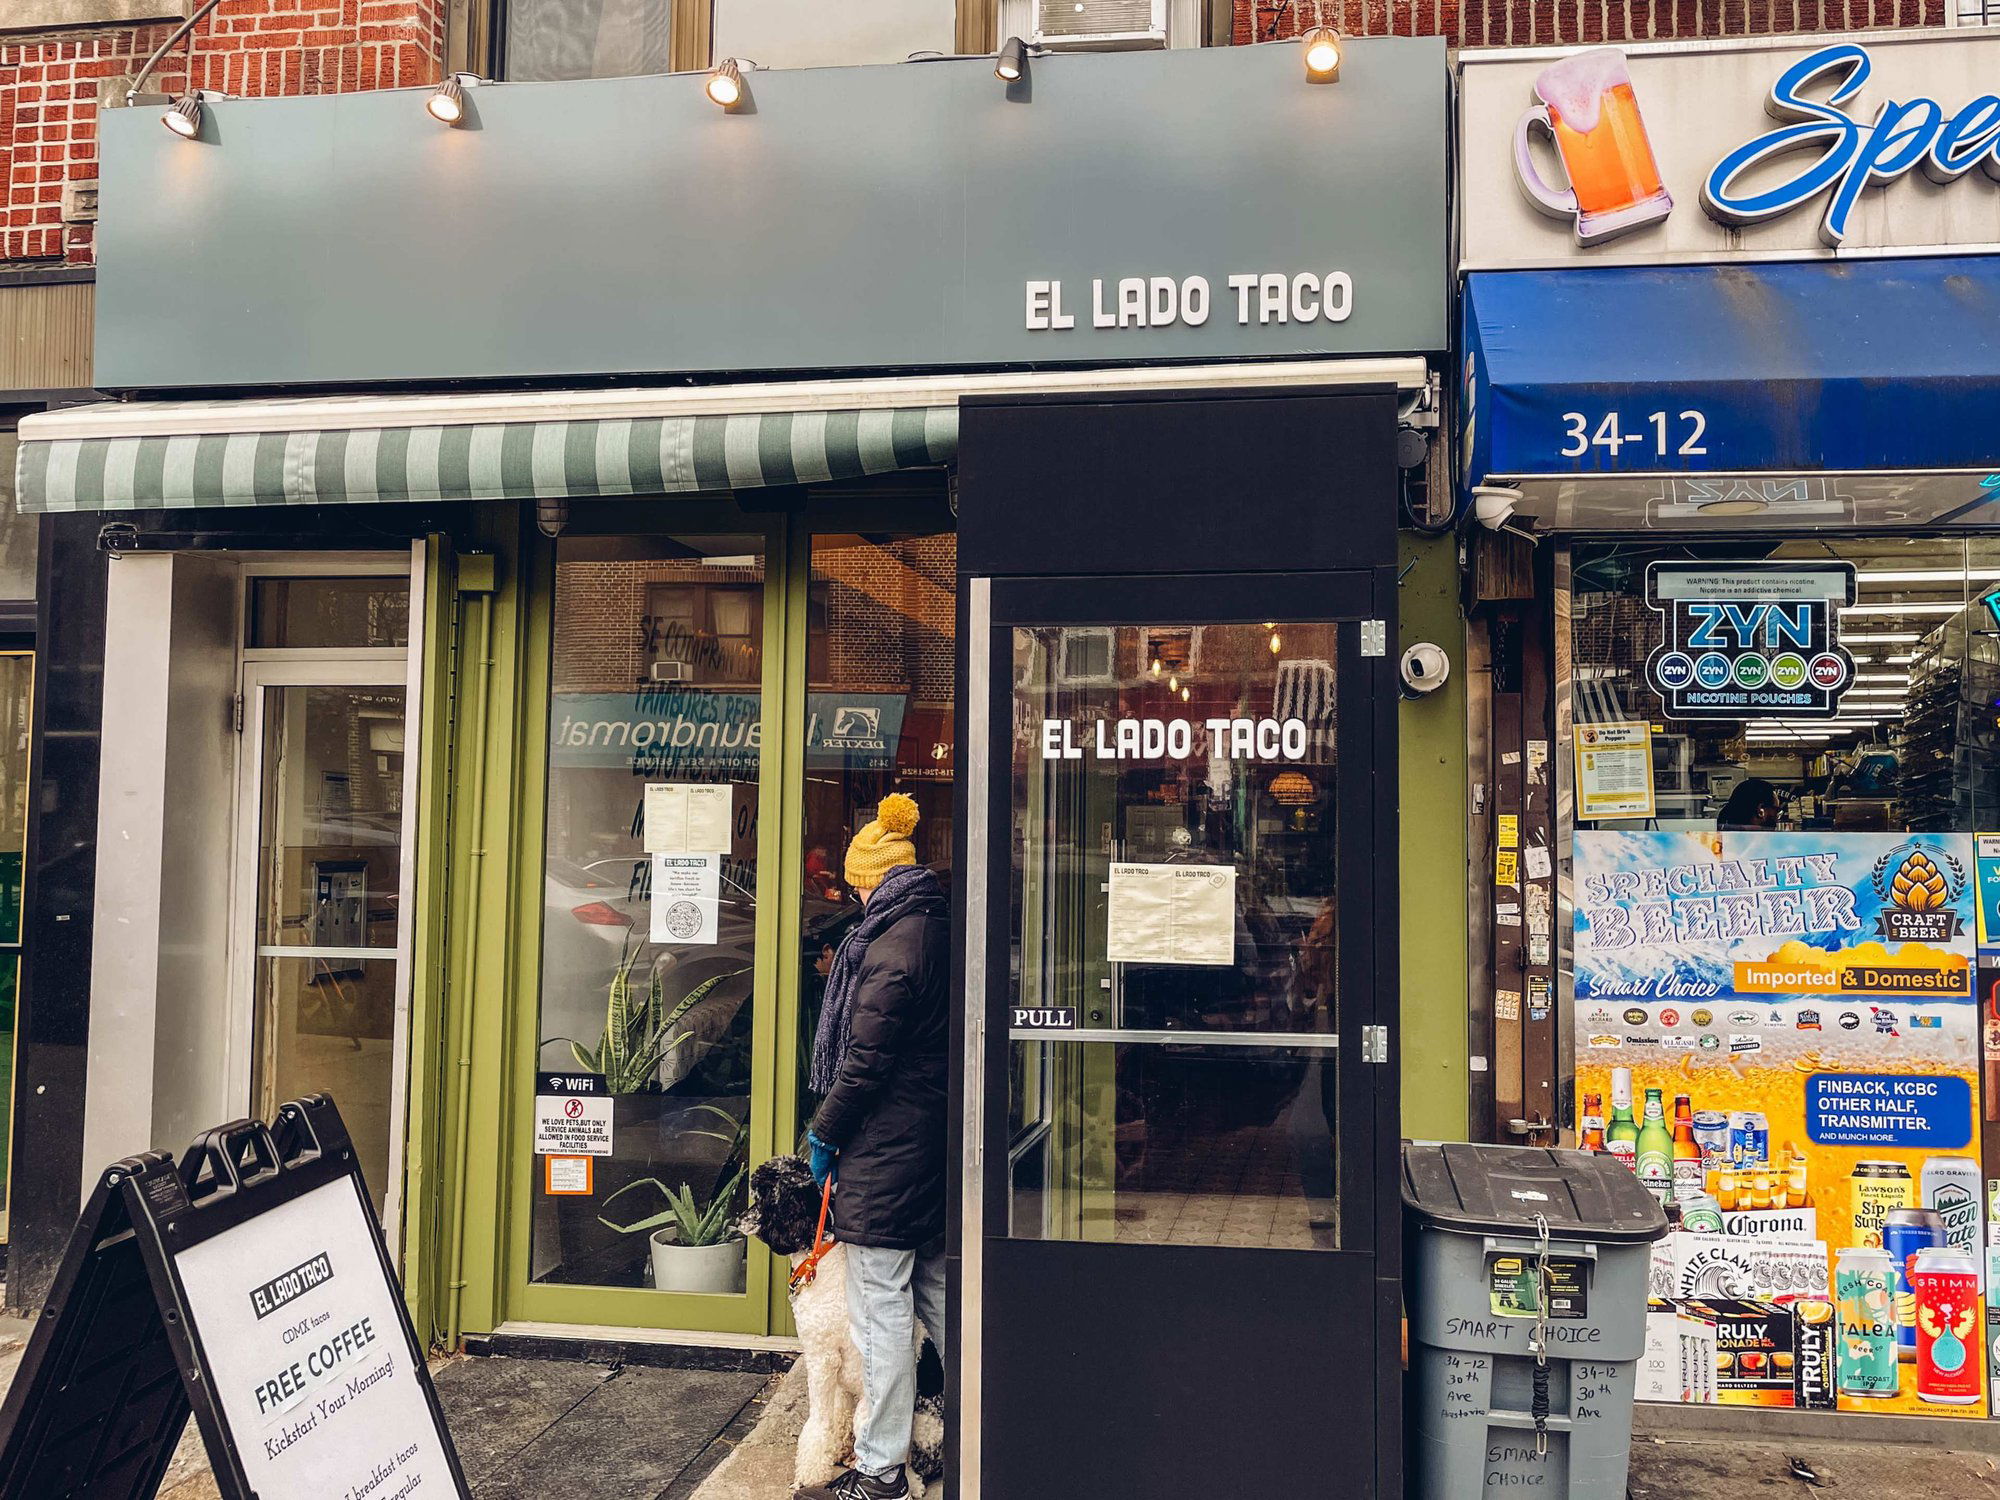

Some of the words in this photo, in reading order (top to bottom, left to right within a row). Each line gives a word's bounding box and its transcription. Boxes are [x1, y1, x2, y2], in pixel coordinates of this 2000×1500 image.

[1701, 43, 2000, 246] Spe
[1026, 281, 1074, 330] EL
[1093, 276, 1210, 328] LADO
[1228, 271, 1352, 324] TACO
[1561, 411, 1706, 458] 34-12
[1736, 578, 1760, 586] product
[1688, 604, 1811, 648] ZYN
[1664, 666, 1686, 675] ZYN
[1702, 666, 1723, 675] ZYN
[1740, 666, 1761, 675] ZYN
[1777, 666, 1799, 675] ZYN
[1815, 666, 1837, 676] ZYN
[1687, 693, 1748, 704] NICOTINE
[1751, 693, 1812, 704] POUCHES
[1043, 719, 1082, 759] EL
[1096, 719, 1191, 759] LADO
[1206, 718, 1306, 759] TACO
[1585, 853, 1840, 904] SPECIALTY
[1891, 913, 1947, 927] CRAFT
[1900, 928, 1940, 939] BEER
[1589, 972, 1650, 997] Smart
[1655, 972, 1722, 998] Choice
[1746, 968, 1836, 988] Imported
[1843, 971, 1858, 986] &
[1864, 970, 1961, 988] Domestic
[1014, 1011, 1072, 1026] PULL
[1626, 1036, 1659, 1044] Omission
[566, 1078, 594, 1091] WiFi
[1818, 1080, 1890, 1096] FINBACK,
[1894, 1082, 1937, 1096] KCBC
[1818, 1098, 1871, 1111] OTHER
[1875, 1099, 1918, 1114] HALF,
[1819, 1115, 1931, 1130] TRANSMITTER.
[1859, 1185, 1905, 1193] Lawson's
[1862, 1200, 1885, 1217] Sip
[1727, 1216, 1805, 1236] Corona
[1855, 1215, 1884, 1230] Suns
[1681, 1251, 1708, 1299] WHITE
[1710, 1248, 1752, 1274] CLAW
[254, 1290, 272, 1315] EL
[271, 1275, 299, 1306] LADO
[298, 1257, 329, 1289] TACO
[1918, 1278, 1976, 1288] GRIMM
[282, 1319, 309, 1344] CDMX
[310, 1311, 330, 1327] tacos
[1446, 1318, 1514, 1341] SMART
[1717, 1324, 1768, 1339] RULY
[1716, 1339, 1759, 1348] ONADE
[254, 1362, 306, 1415] FREE
[308, 1317, 376, 1377] COFFEE
[1445, 1356, 1488, 1369] 34-12
[1648, 1360, 1665, 1368] 100
[1802, 1325, 1821, 1397] TRULY
[1577, 1366, 1617, 1379] 34-12
[1447, 1392, 1472, 1401] Ave
[1577, 1384, 1611, 1401] 30th
[264, 1412, 318, 1460] Kickstart
[317, 1395, 346, 1420] Your
[346, 1353, 395, 1400] Morning!
[1577, 1406, 1601, 1418] Ave
[1488, 1446, 1552, 1462] SMART
[352, 1458, 396, 1500] breakfast
[396, 1443, 418, 1465] tacos
